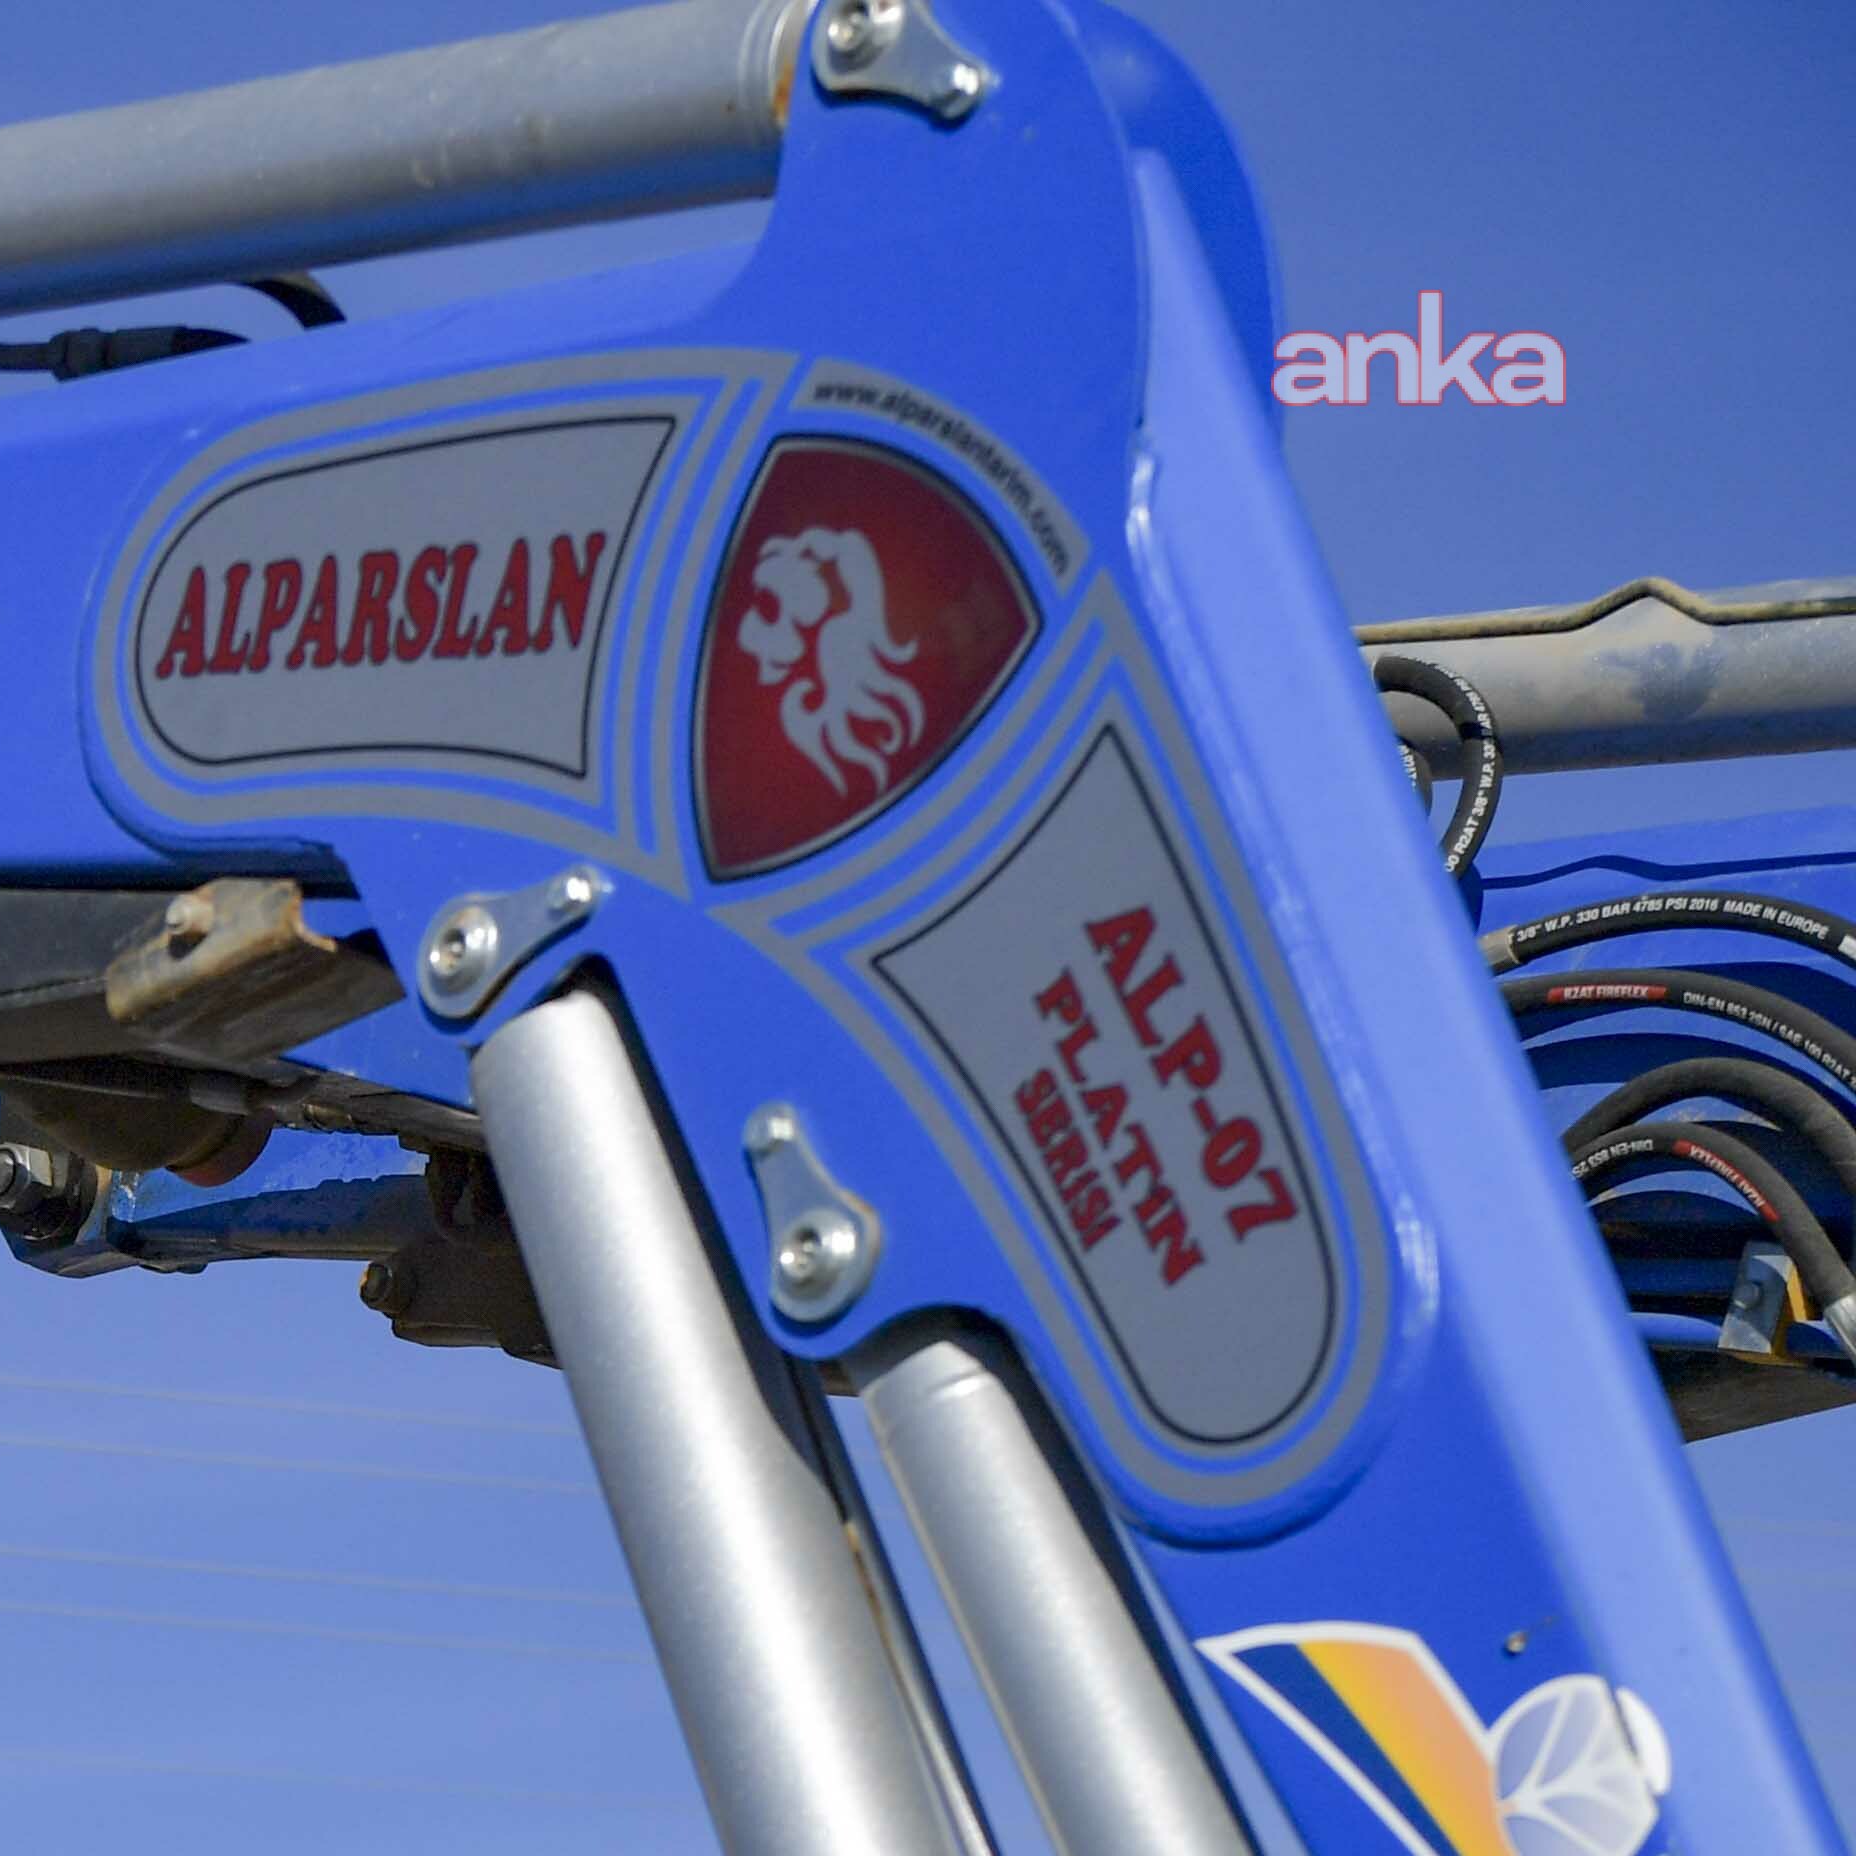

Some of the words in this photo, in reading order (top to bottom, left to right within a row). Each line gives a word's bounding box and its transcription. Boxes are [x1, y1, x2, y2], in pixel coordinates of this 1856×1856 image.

[155, 530, 607, 678] ALPARSLAN
[1454, 817, 1478, 854] R2AT
[1545, 916, 1573, 932] W.P.
[1602, 902, 1630, 918] BAR
[1665, 897, 1687, 910] PSI
[1723, 900, 1762, 917] MADE
[1762, 906, 1777, 920] IN
[1777, 910, 1829, 939] EUROPE
[1084, 905, 1299, 1244] ALP-07
